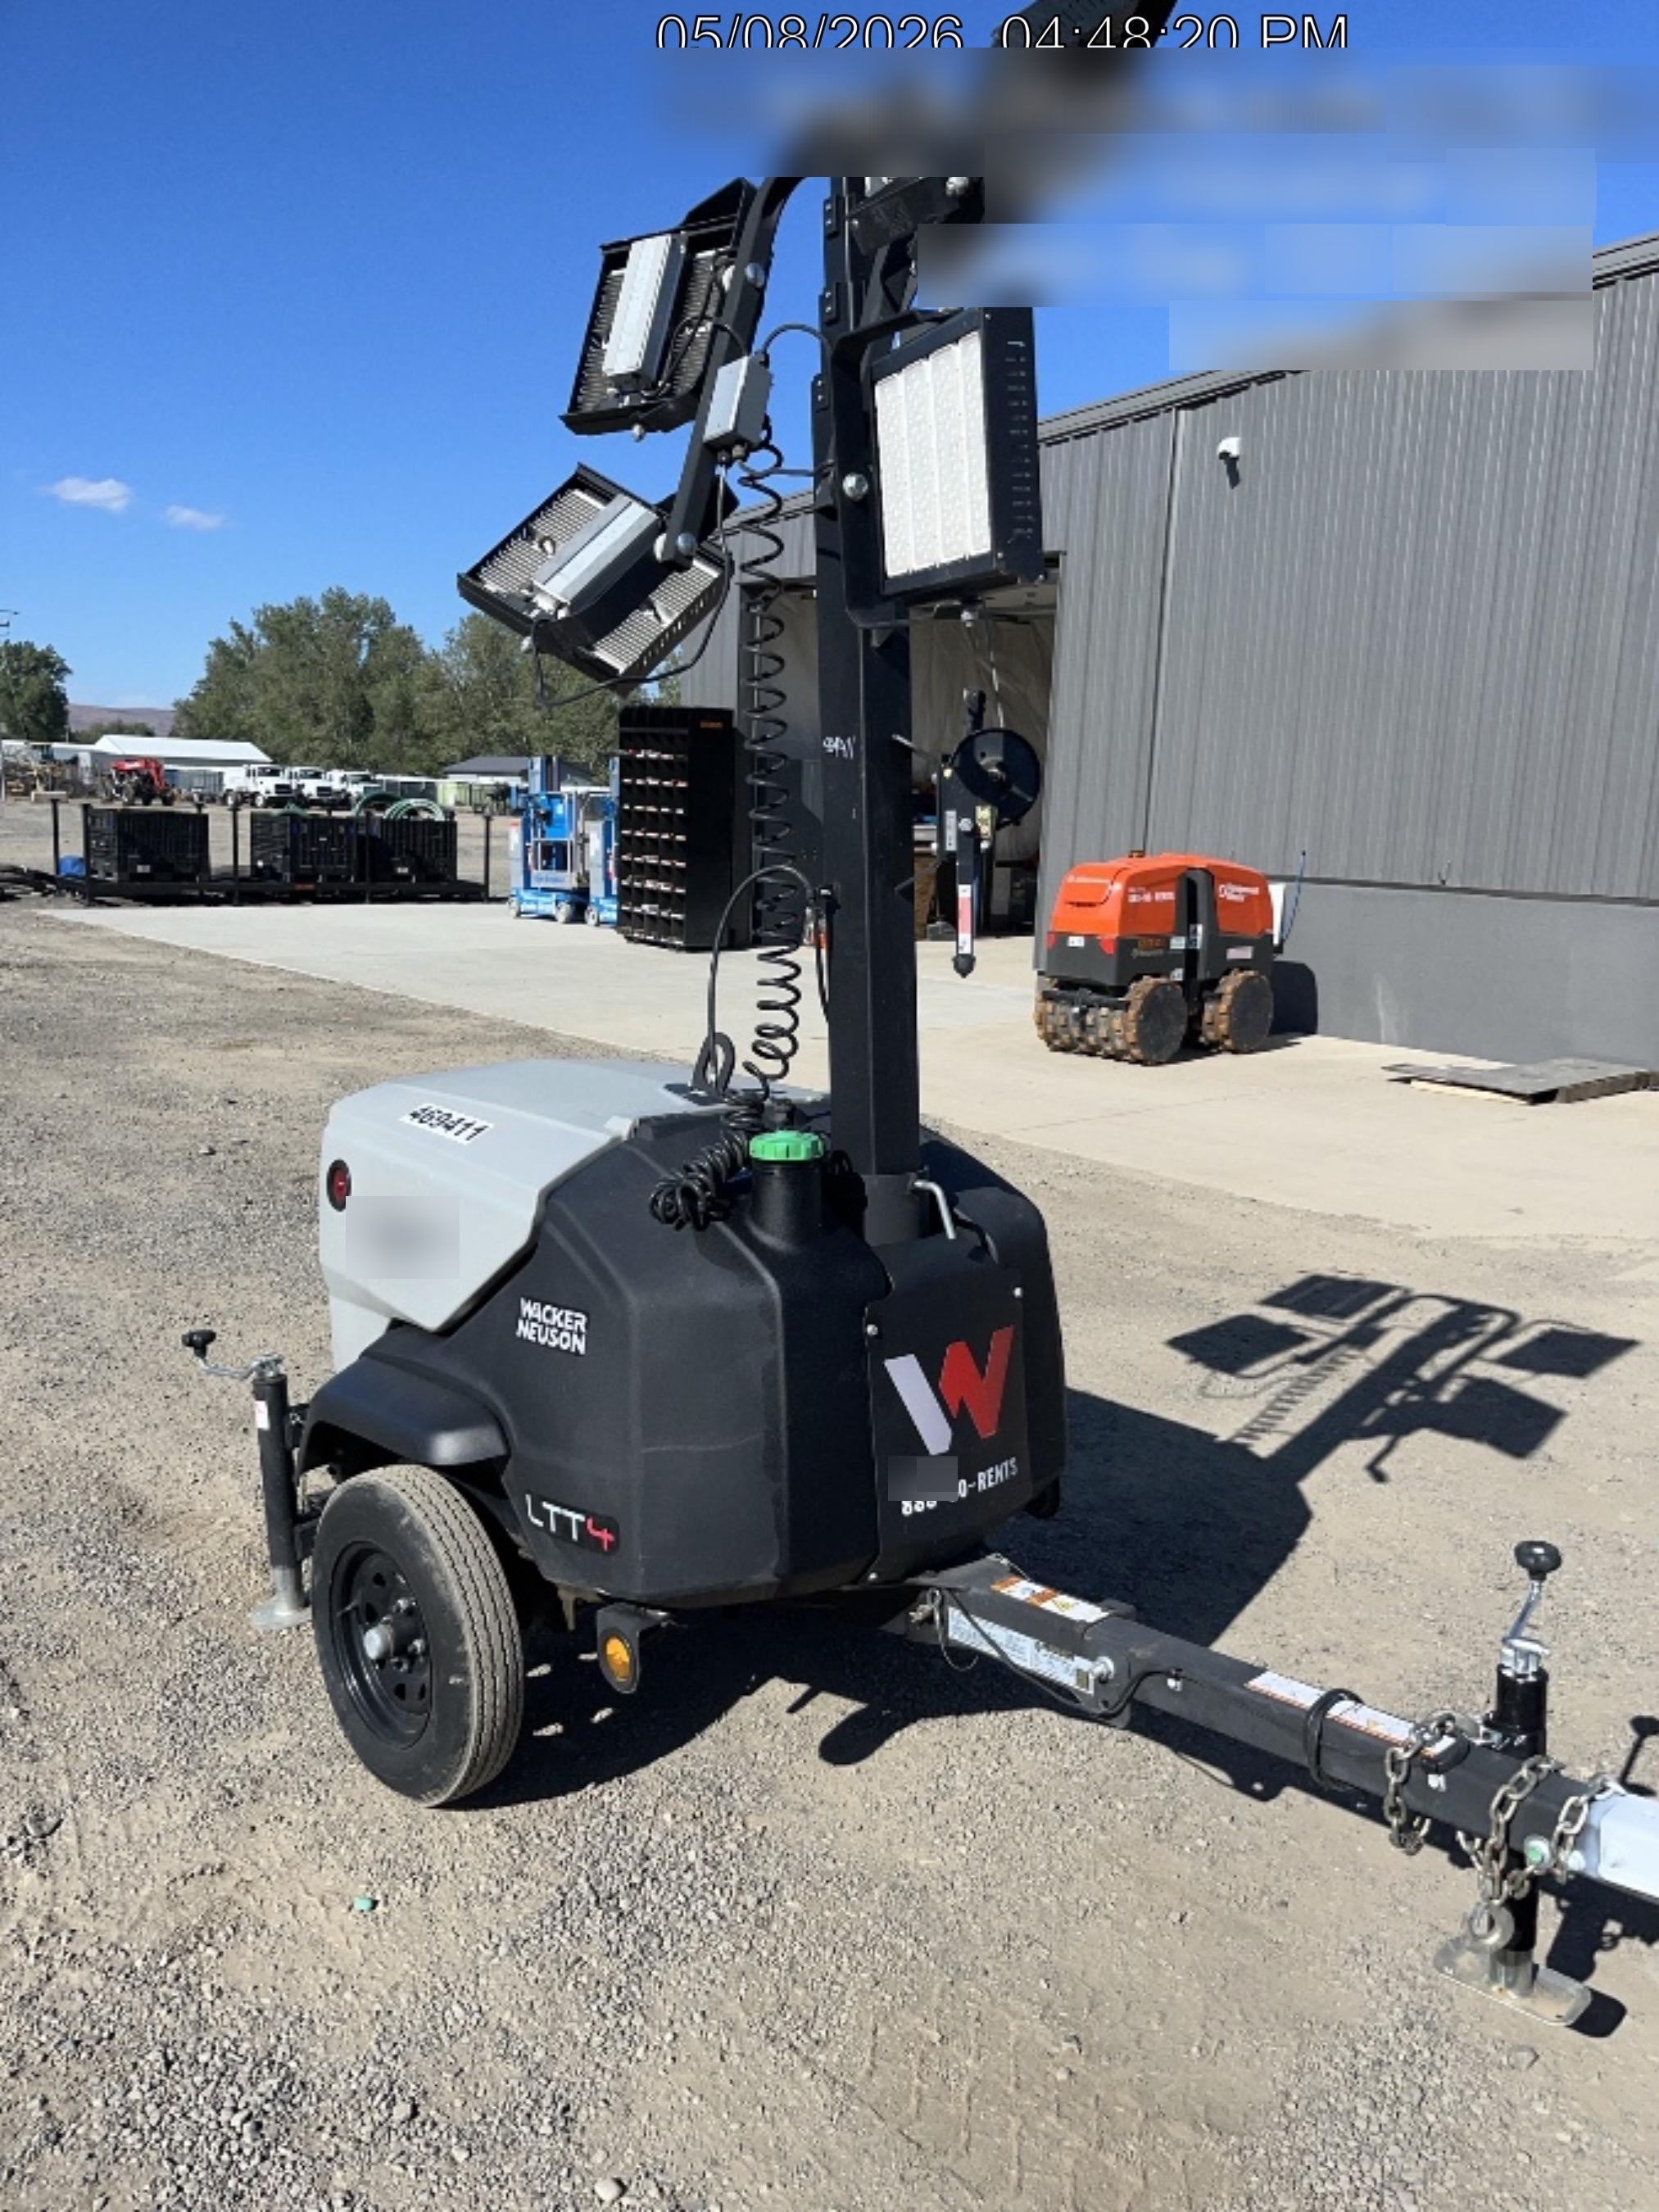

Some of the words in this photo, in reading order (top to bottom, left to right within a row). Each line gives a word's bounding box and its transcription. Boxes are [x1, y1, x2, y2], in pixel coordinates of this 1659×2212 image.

[409, 1105, 489, 1141] 469411
[519, 1297, 587, 1334] WACKER
[515, 1318, 587, 1355] NEUSON
[525, 1494, 615, 1552] LTT4
